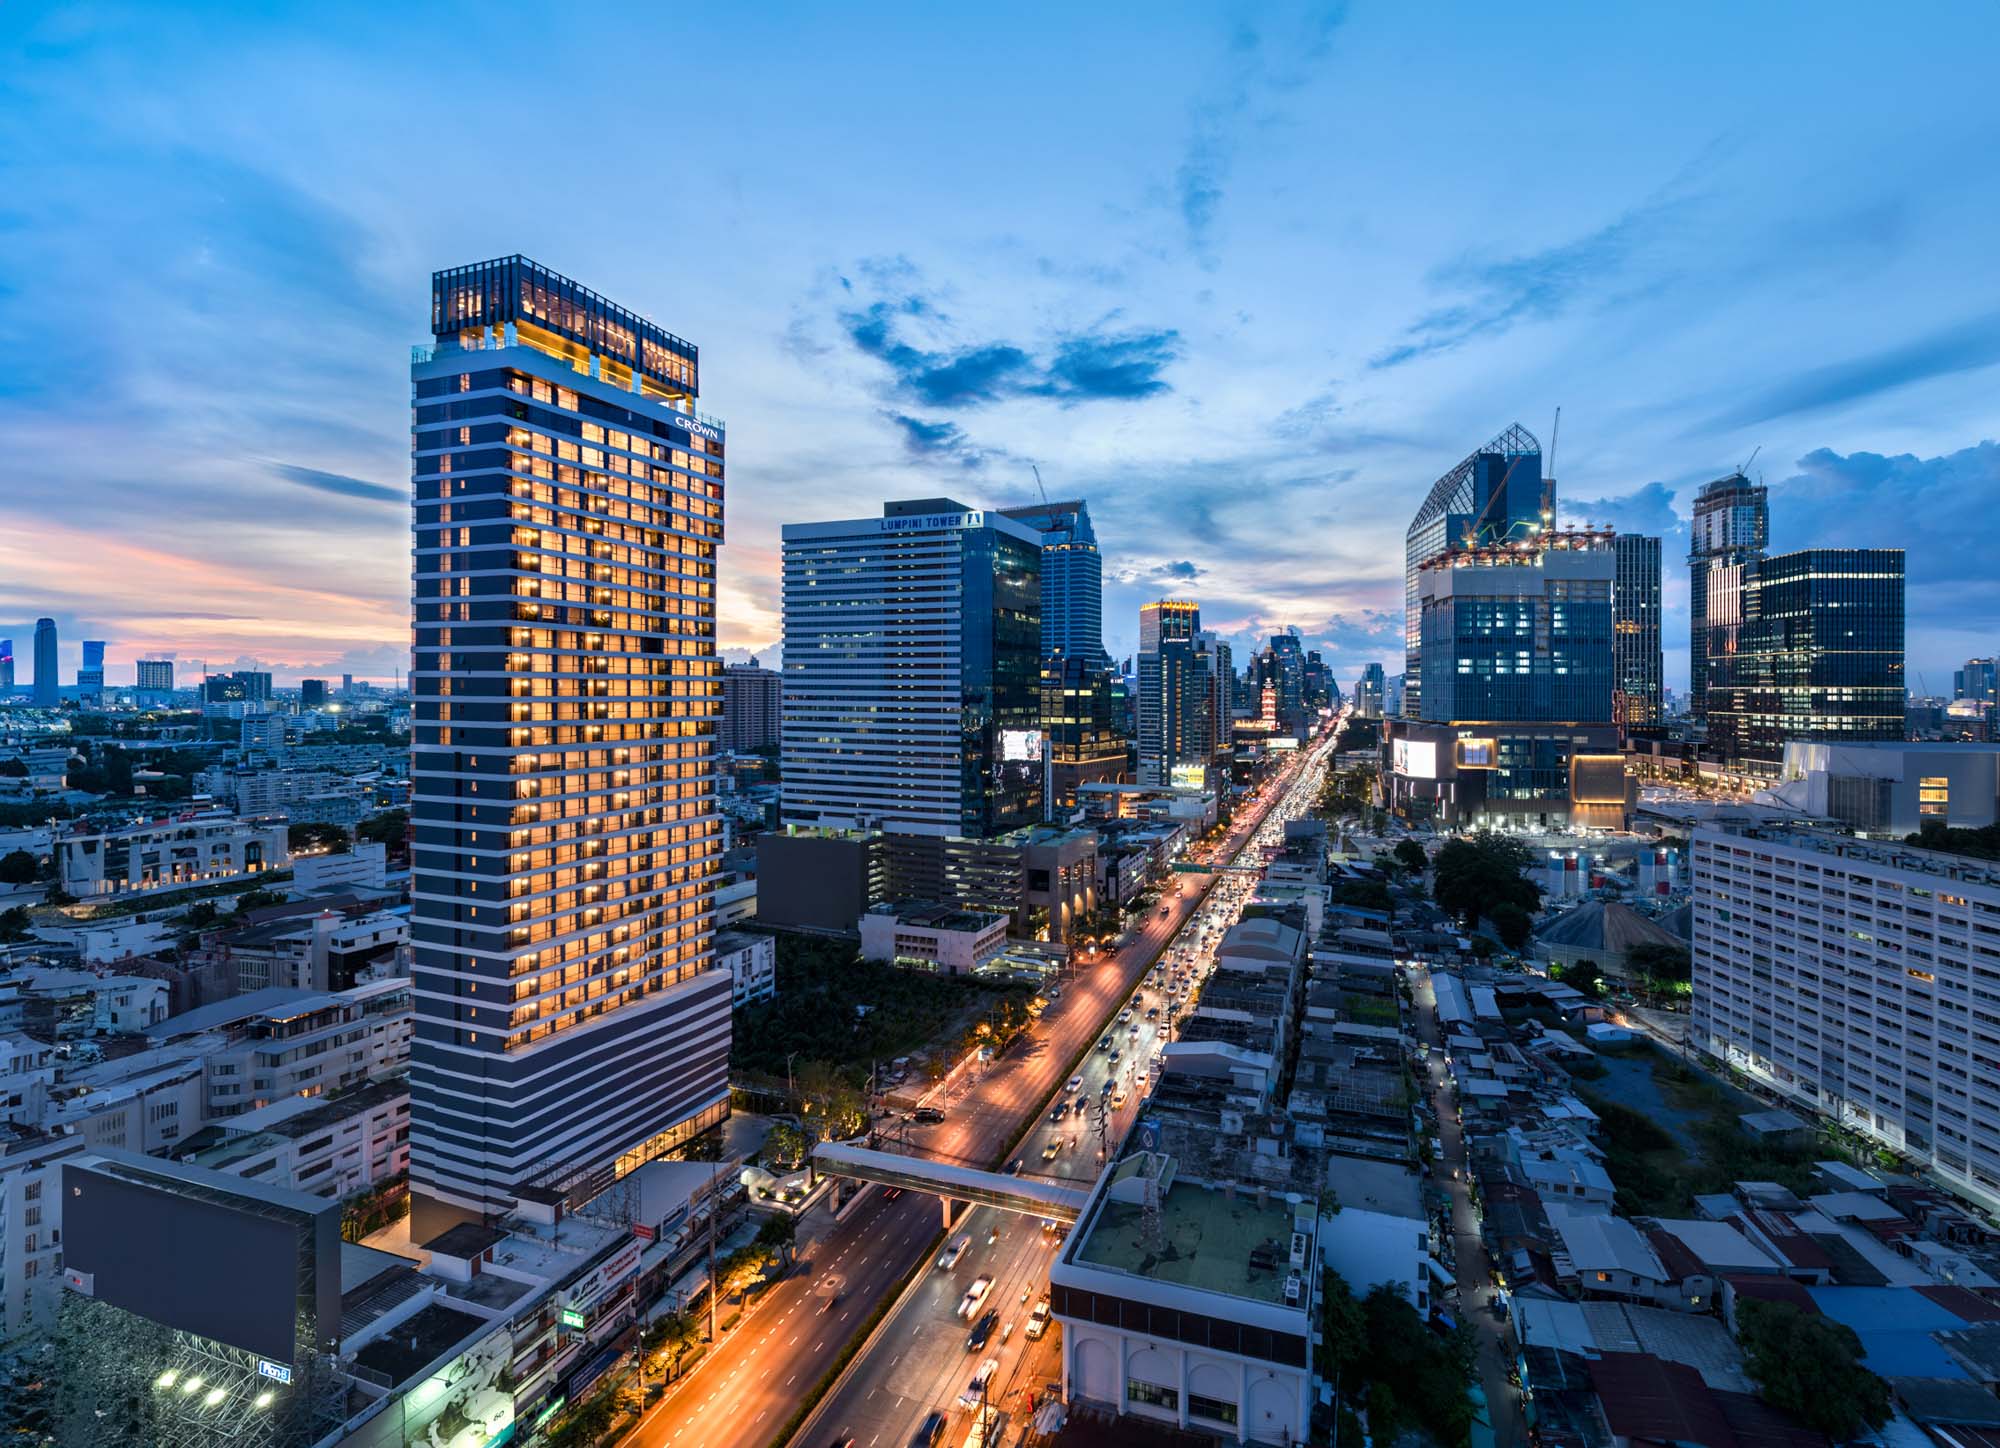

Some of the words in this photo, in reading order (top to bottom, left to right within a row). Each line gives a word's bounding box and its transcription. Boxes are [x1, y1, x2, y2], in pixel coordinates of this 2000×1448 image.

[675, 416, 718, 439] CROWN
[881, 518, 922, 530] LUMPINI
[926, 515, 961, 528] TOWER
